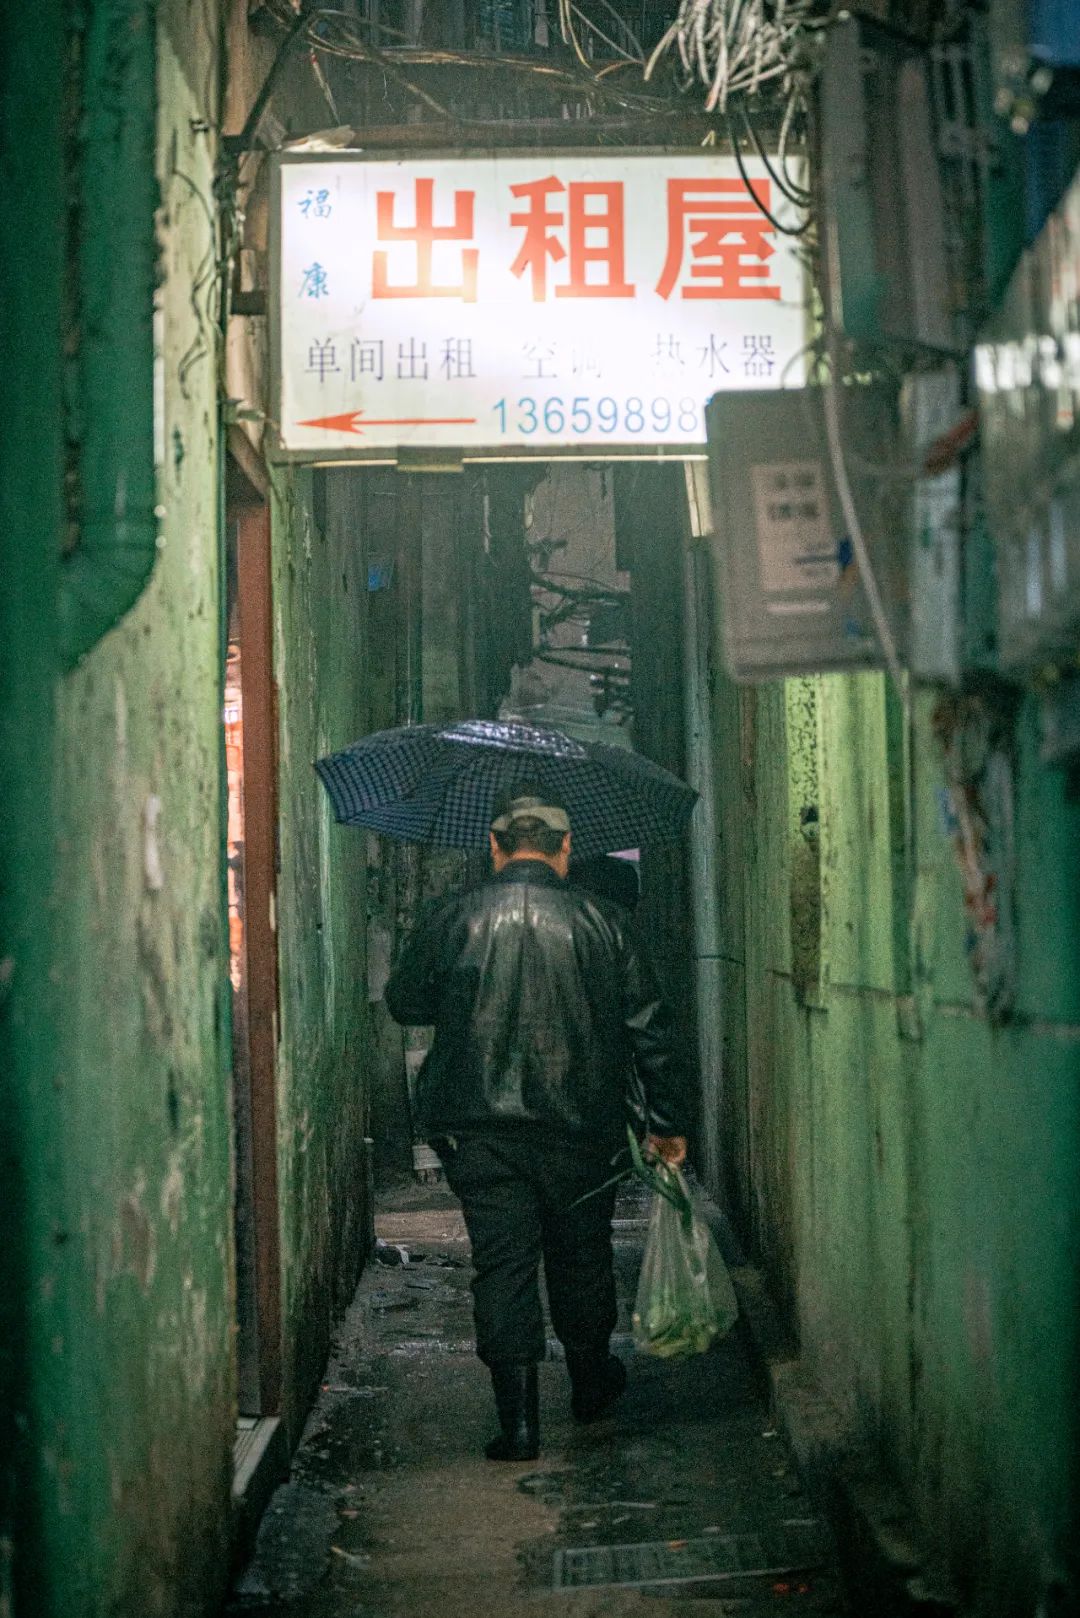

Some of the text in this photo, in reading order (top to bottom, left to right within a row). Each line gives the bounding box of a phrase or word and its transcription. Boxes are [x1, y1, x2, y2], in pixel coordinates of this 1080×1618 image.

[298, 189, 332, 299] 福康
[371, 174, 782, 303] 出租屋
[305, 336, 478, 383] 单间出租
[492, 396, 713, 434] 13659898
